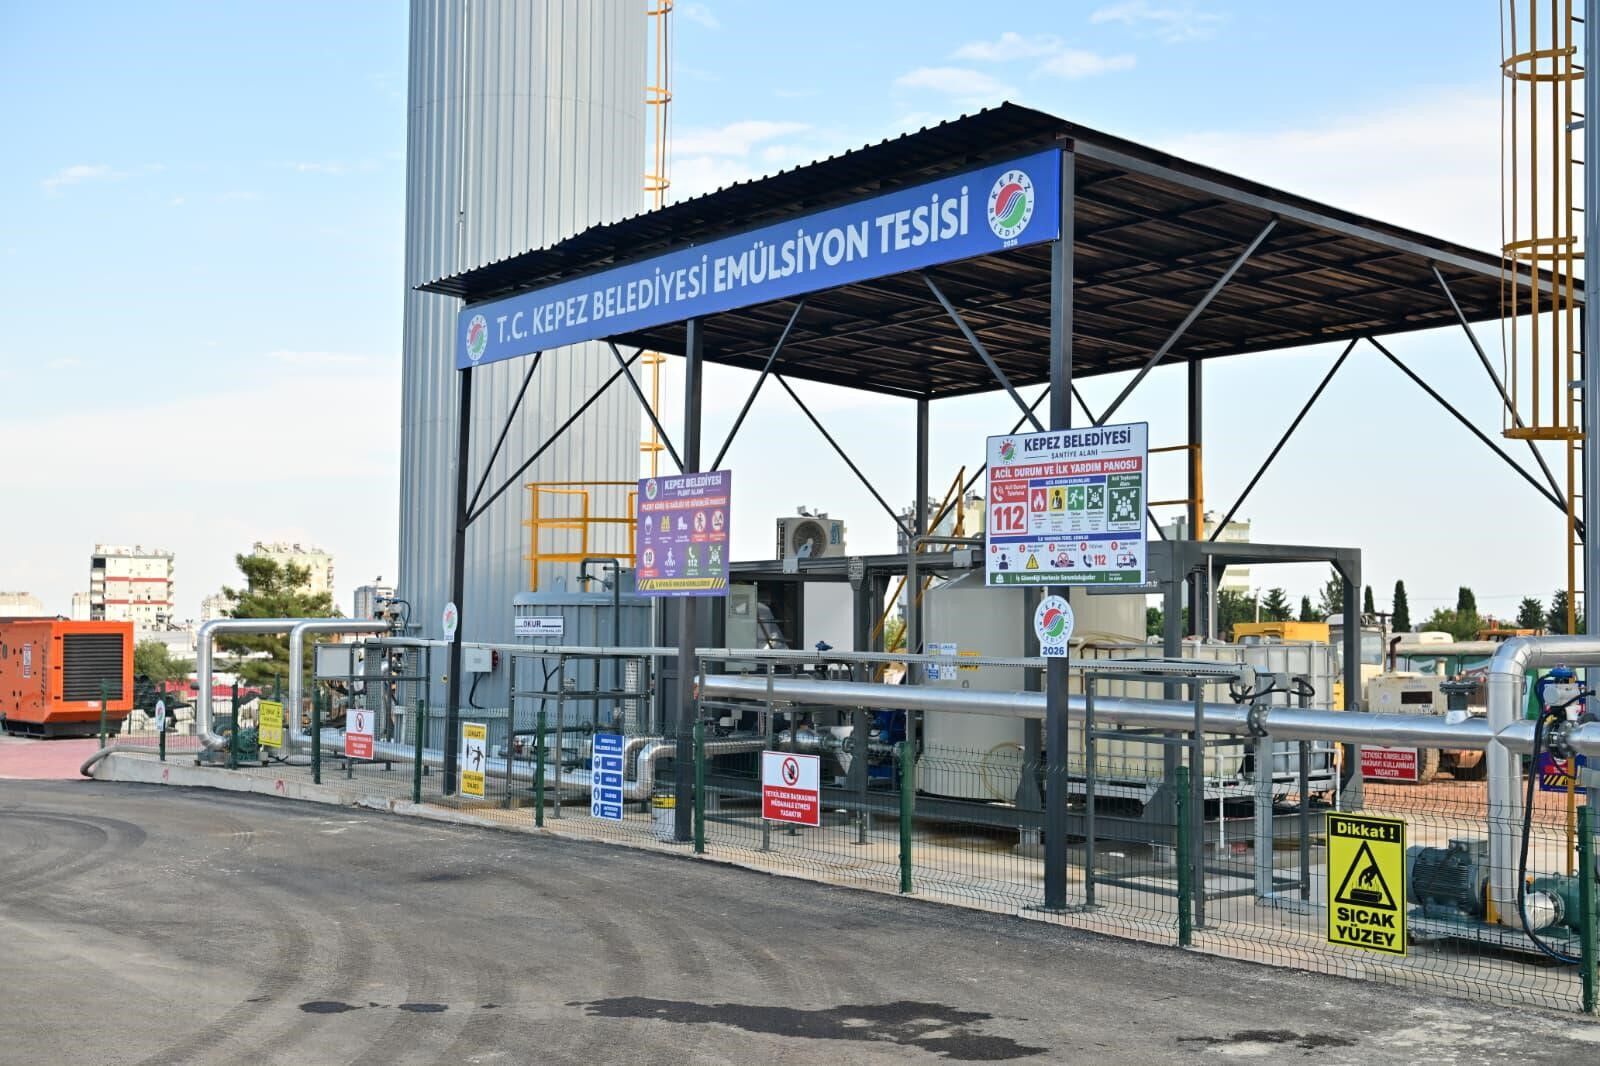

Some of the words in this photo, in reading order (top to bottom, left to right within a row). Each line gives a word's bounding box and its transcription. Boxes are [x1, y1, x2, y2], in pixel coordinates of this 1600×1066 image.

[497, 312, 527, 344] T.C.
[533, 294, 588, 336] KEPEZ
[592, 254, 708, 321] BELEDİYESİ
[714, 220, 868, 294] EMÜLSİYON
[876, 185, 969, 254] TESİSİ
[1024, 436, 1060, 452] KEPEZ
[1064, 426, 1131, 448] BELEDİYESİ
[995, 466, 1012, 479] ACİL
[1014, 466, 1042, 478] DURUM
[1044, 465, 1054, 475] VE
[1056, 463, 1068, 474] İLK
[1071, 462, 1101, 473] YARDIM
[1104, 459, 1137, 471] PANOSU
[664, 478, 685, 490] KEPEZ
[686, 472, 722, 488] BELEDİYESİ
[994, 506, 1024, 530] 112
[1094, 555, 1106, 566] 112
[1043, 646, 1064, 655] 2026
[1375, 768, 1399, 776] YASAKTIR
[780, 810, 802, 818] YASAKTIR
[1337, 822, 1385, 838] Dikkat
[1390, 827, 1394, 839] !
[1337, 907, 1395, 928] SICAK
[1336, 924, 1396, 947] YÜZEY
